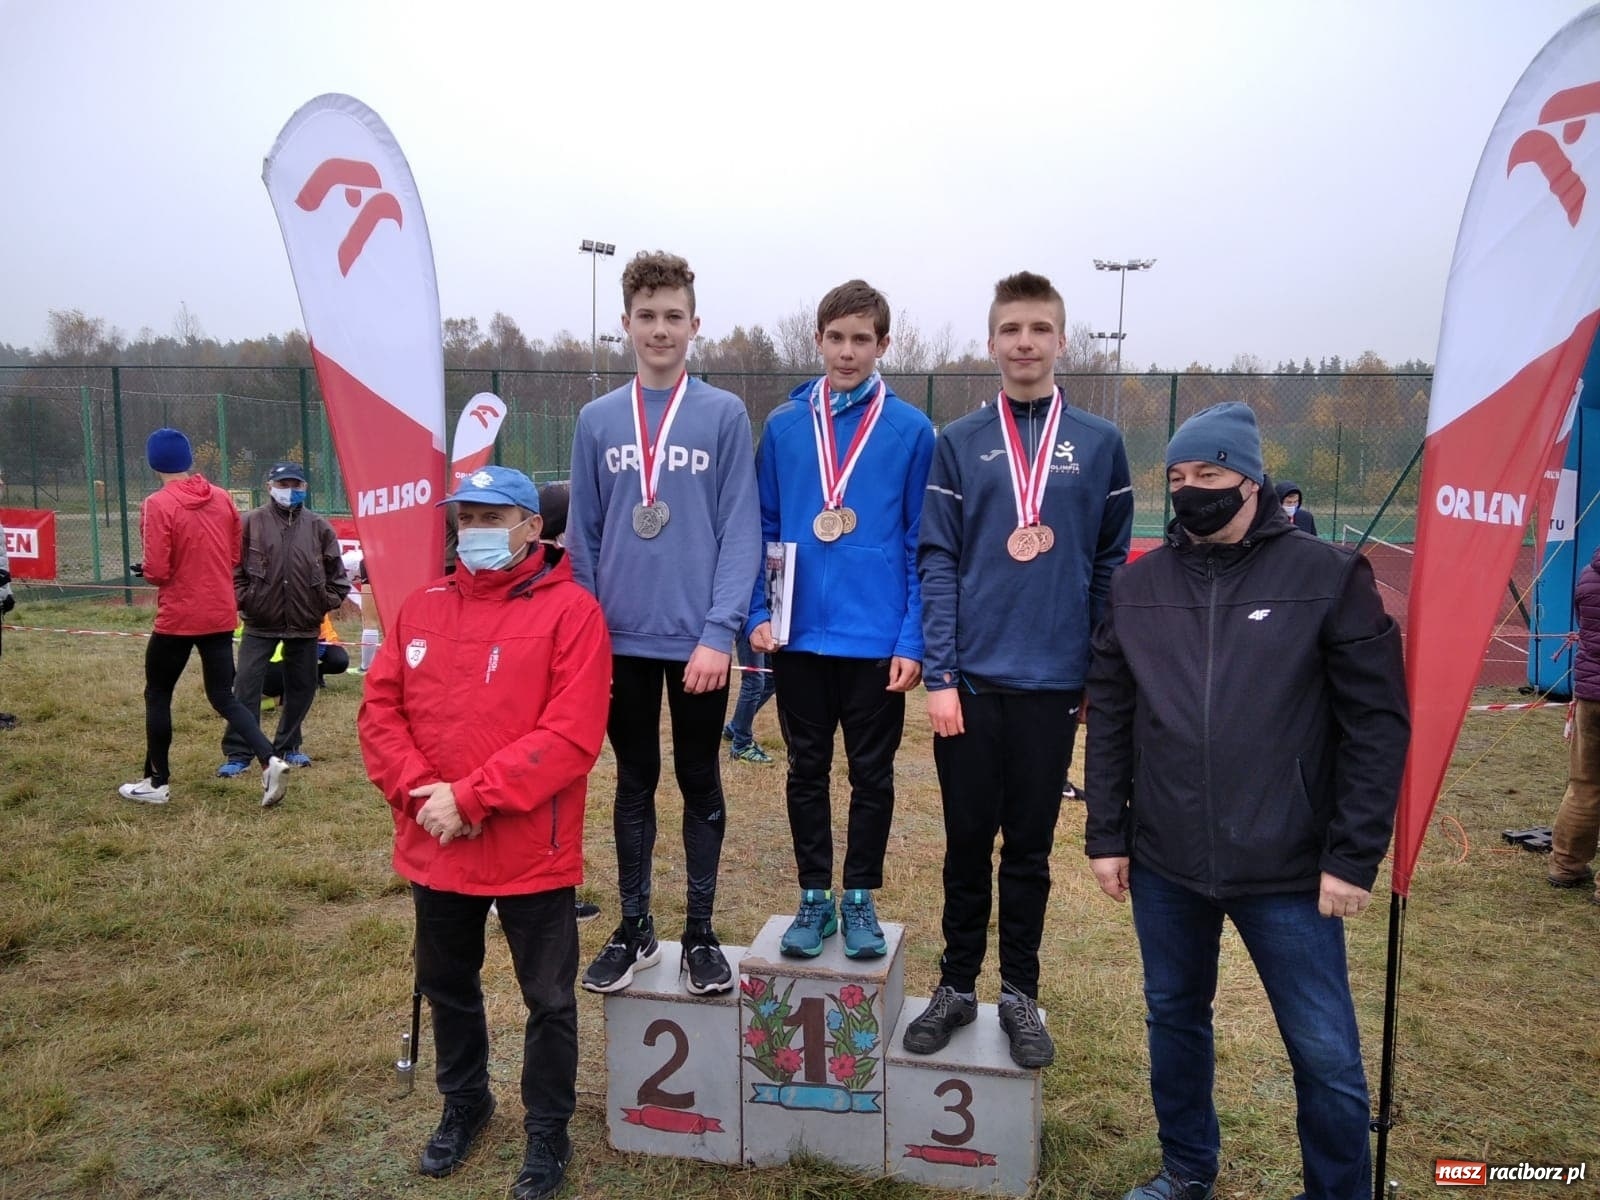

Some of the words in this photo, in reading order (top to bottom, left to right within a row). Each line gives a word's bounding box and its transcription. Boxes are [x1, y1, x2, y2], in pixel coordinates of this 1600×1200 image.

[605, 444, 710, 475] CRPP
[1436, 484, 1527, 526] ORLEN
[5, 532, 32, 553] EN
[1247, 609, 1271, 621] 4F
[783, 997, 827, 1083] 1
[636, 1018, 695, 1109] 2
[930, 1078, 975, 1146] 3
